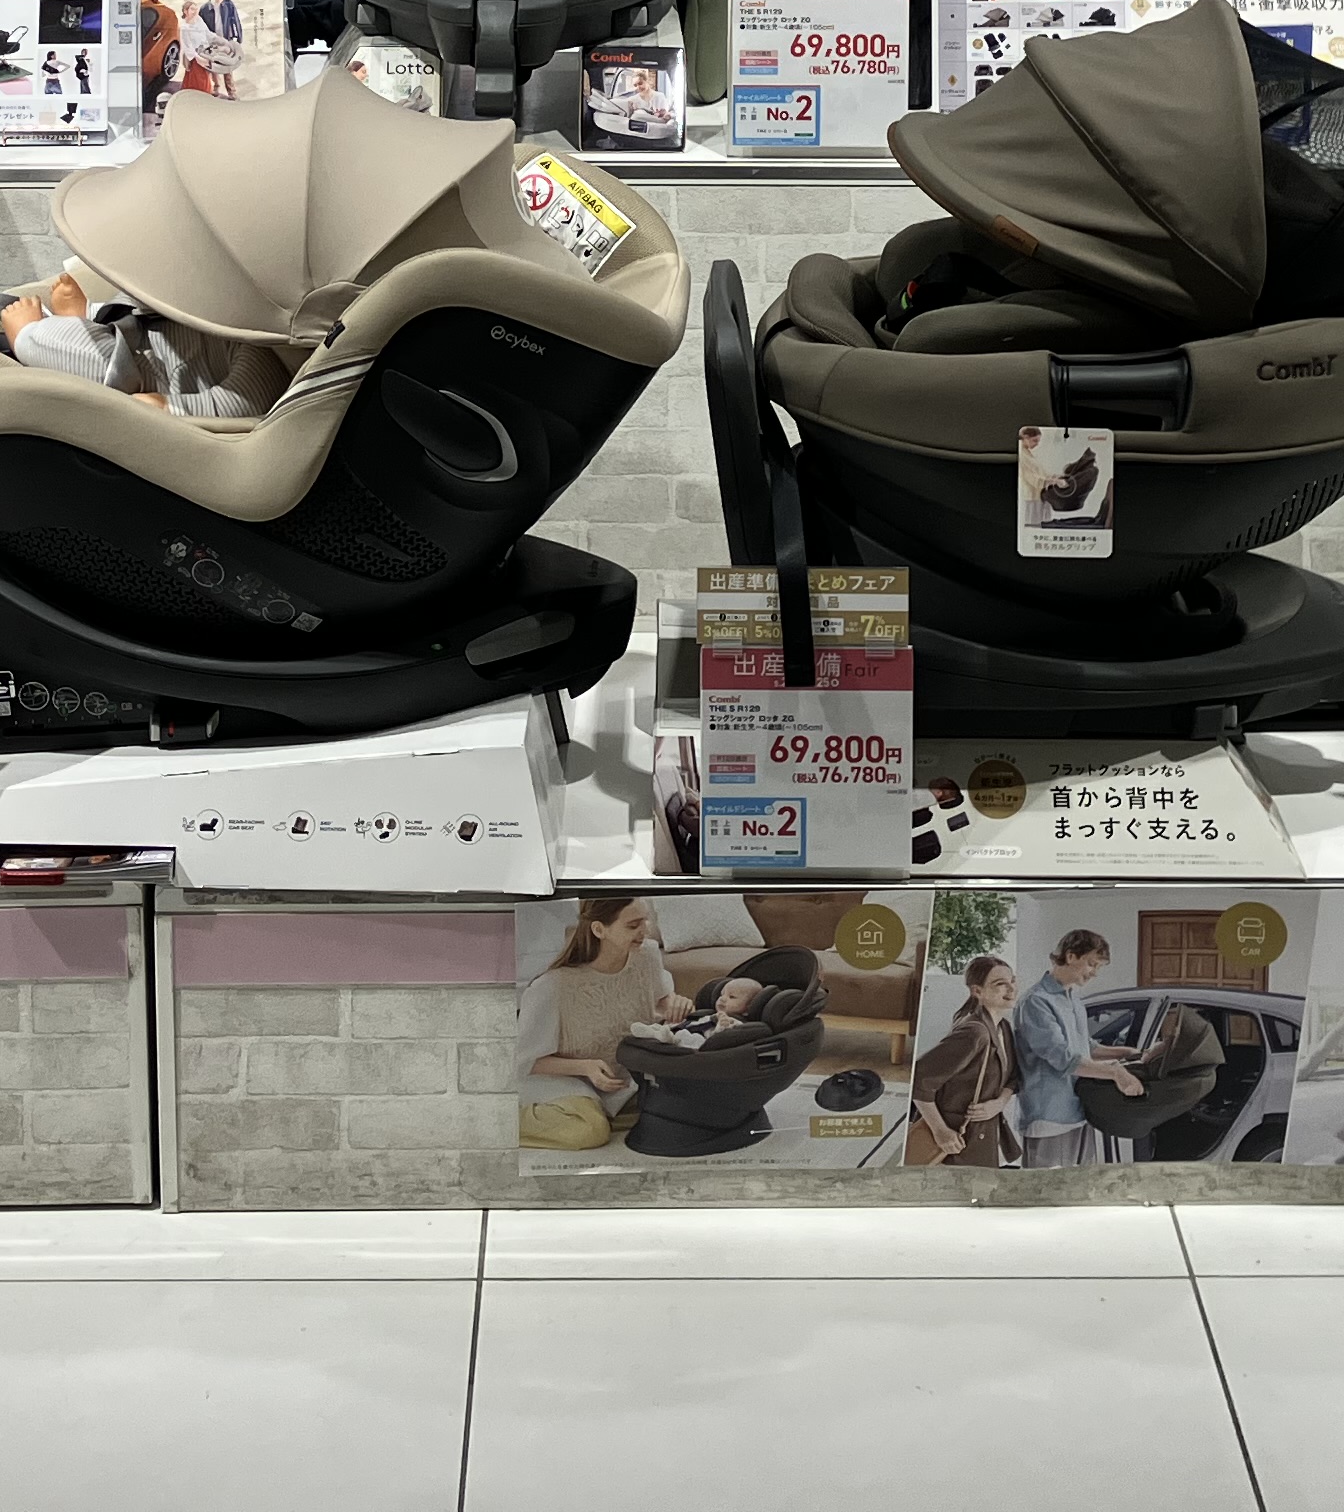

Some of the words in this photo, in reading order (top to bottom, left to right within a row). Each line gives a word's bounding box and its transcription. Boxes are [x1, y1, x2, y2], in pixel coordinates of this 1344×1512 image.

[790, 34, 900, 58] 69,800円
[591, 52, 634, 63] Combi
[808, 60, 900, 76] (税込76,780円)
[386, 61, 435, 76] Lotta
[767, 94, 812, 122] No.2
[568, 182, 603, 214] AIRBAG
[504, 330, 547, 357] cybex
[1256, 354, 1338, 383] Combi
[844, 663, 880, 678] Fair
[708, 695, 741, 703] Combi
[769, 735, 902, 764] 69,800円
[791, 766, 901, 785] (税込76,780円)
[1049, 764, 1185, 778] フラットクッションなら
[1050, 786, 1200, 811] 首から背中を
[742, 805, 797, 837] No.2
[1054, 817, 1236, 842] まっすぐ支える。
[856, 950, 885, 958] HOME
[1241, 947, 1261, 957] CAR
